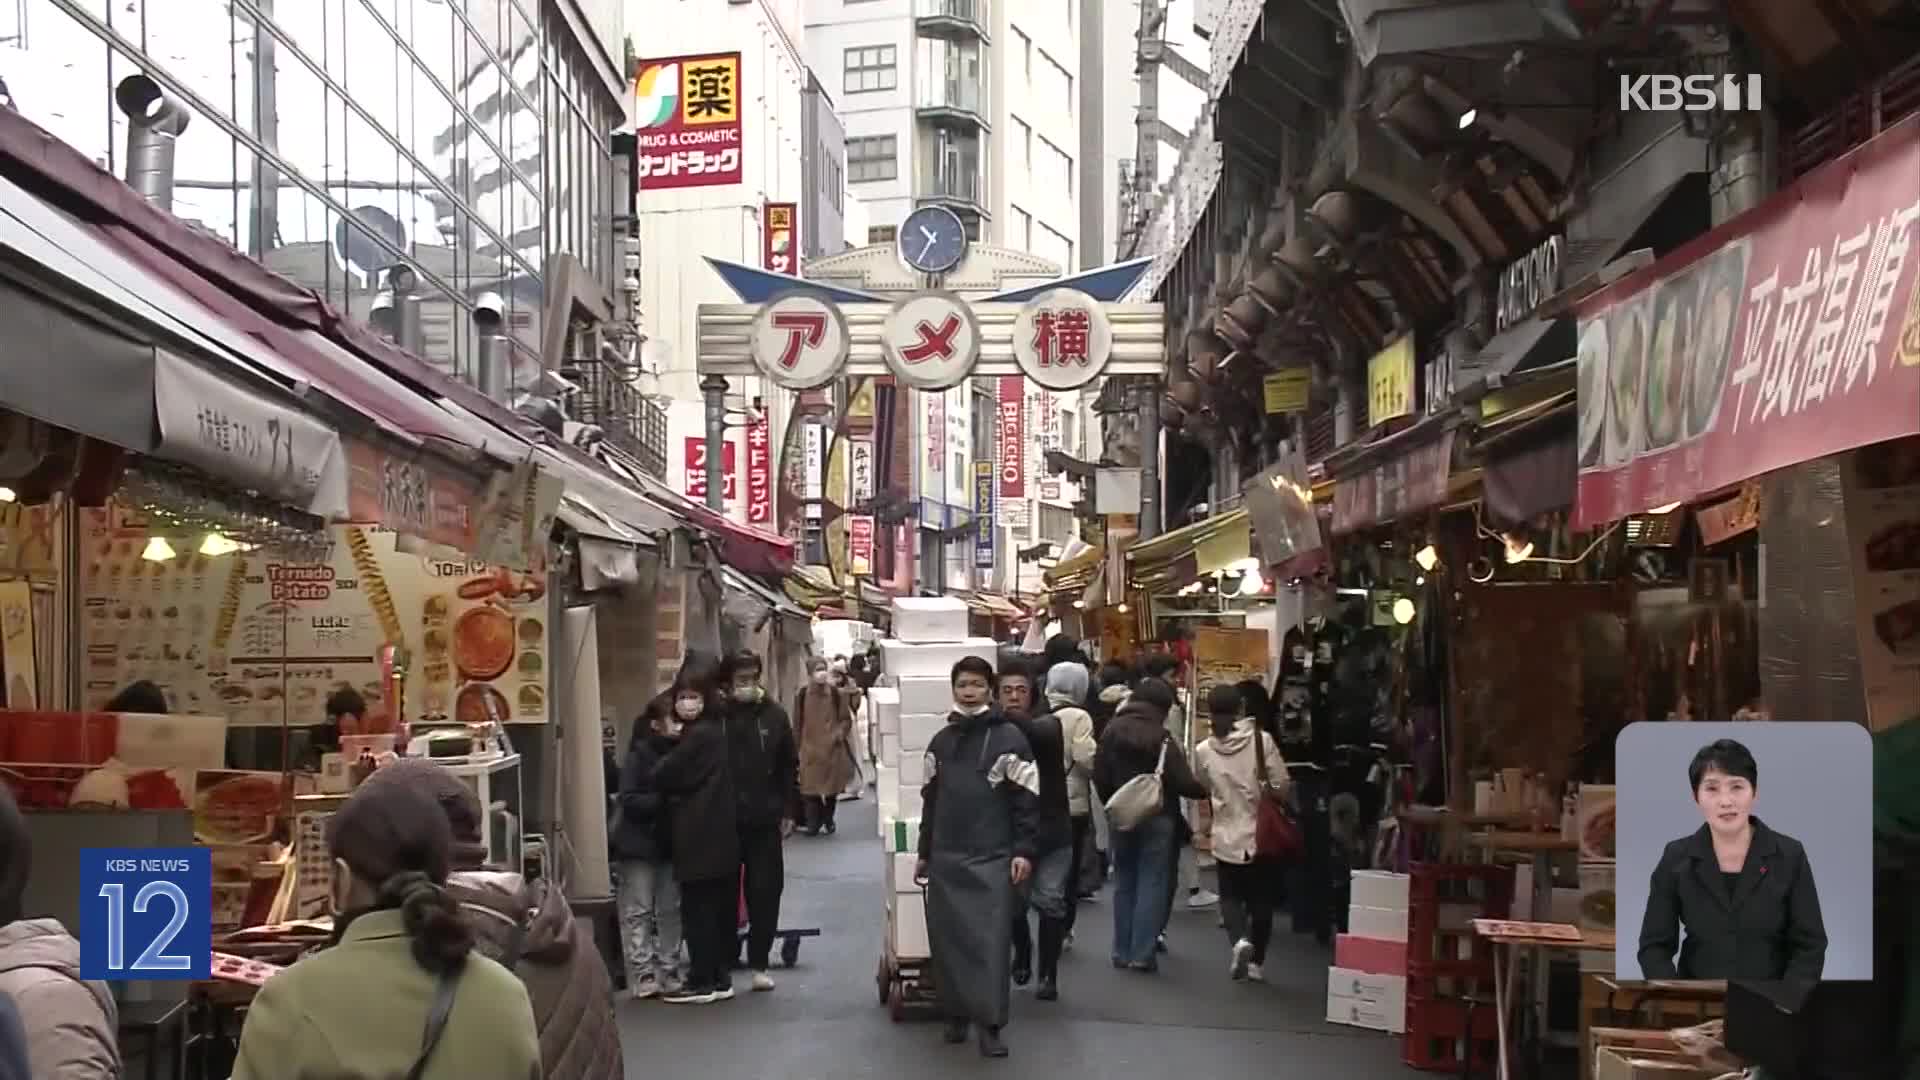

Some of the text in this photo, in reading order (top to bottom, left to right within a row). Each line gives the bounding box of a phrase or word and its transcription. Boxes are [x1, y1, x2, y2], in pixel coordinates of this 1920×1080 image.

[688, 65, 731, 117] 薬
[670, 132, 679, 145] &
[680, 129, 739, 144] COSMETIC
[771, 309, 1089, 369] アメ横
